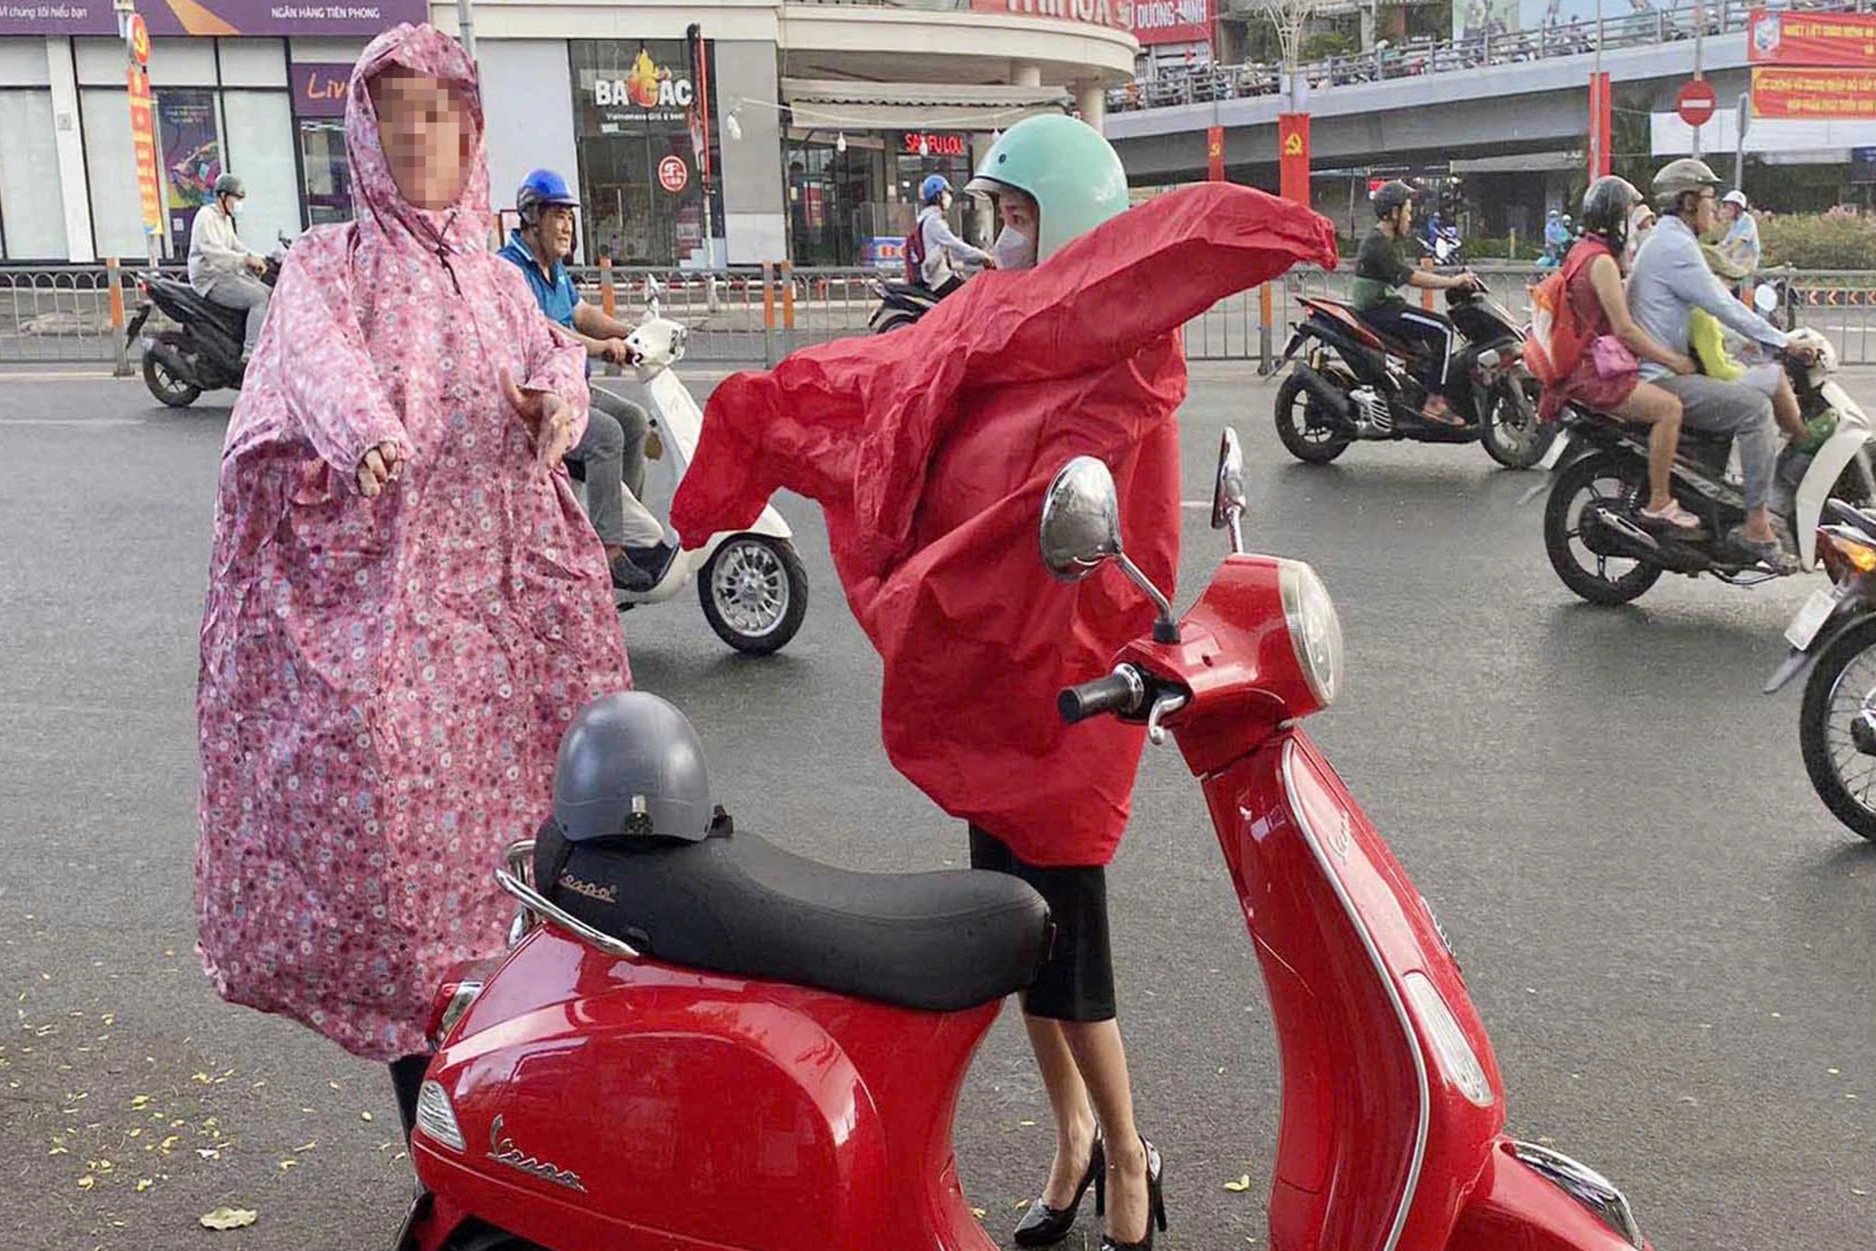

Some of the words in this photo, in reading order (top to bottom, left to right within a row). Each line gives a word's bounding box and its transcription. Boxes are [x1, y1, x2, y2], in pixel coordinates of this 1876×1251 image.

[271, 5, 297, 18] NGÂN
[299, 5, 324, 18] HÀNG
[348, 7, 379, 19] PHONG
[308, 73, 350, 98] Liv
[486, 1113, 588, 1193] Vespa
